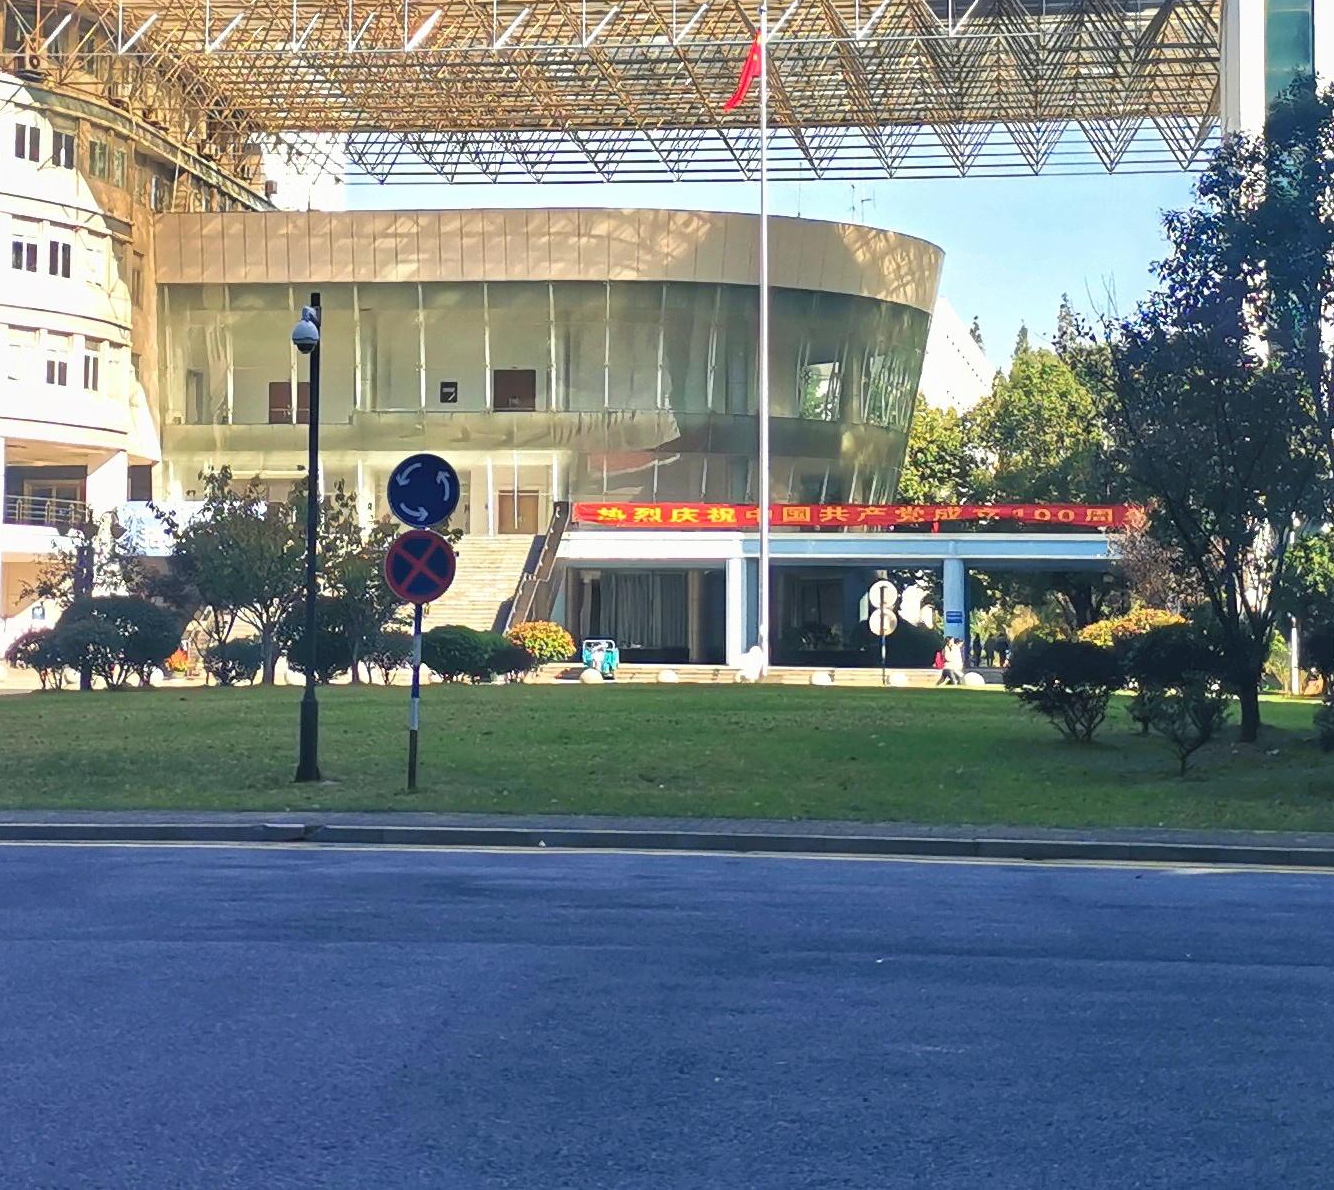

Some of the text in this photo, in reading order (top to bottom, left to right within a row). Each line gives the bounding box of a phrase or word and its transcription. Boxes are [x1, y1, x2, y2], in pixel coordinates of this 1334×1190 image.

[597, 506, 1145, 524] 热烈庆祝中国共产党成立100周
